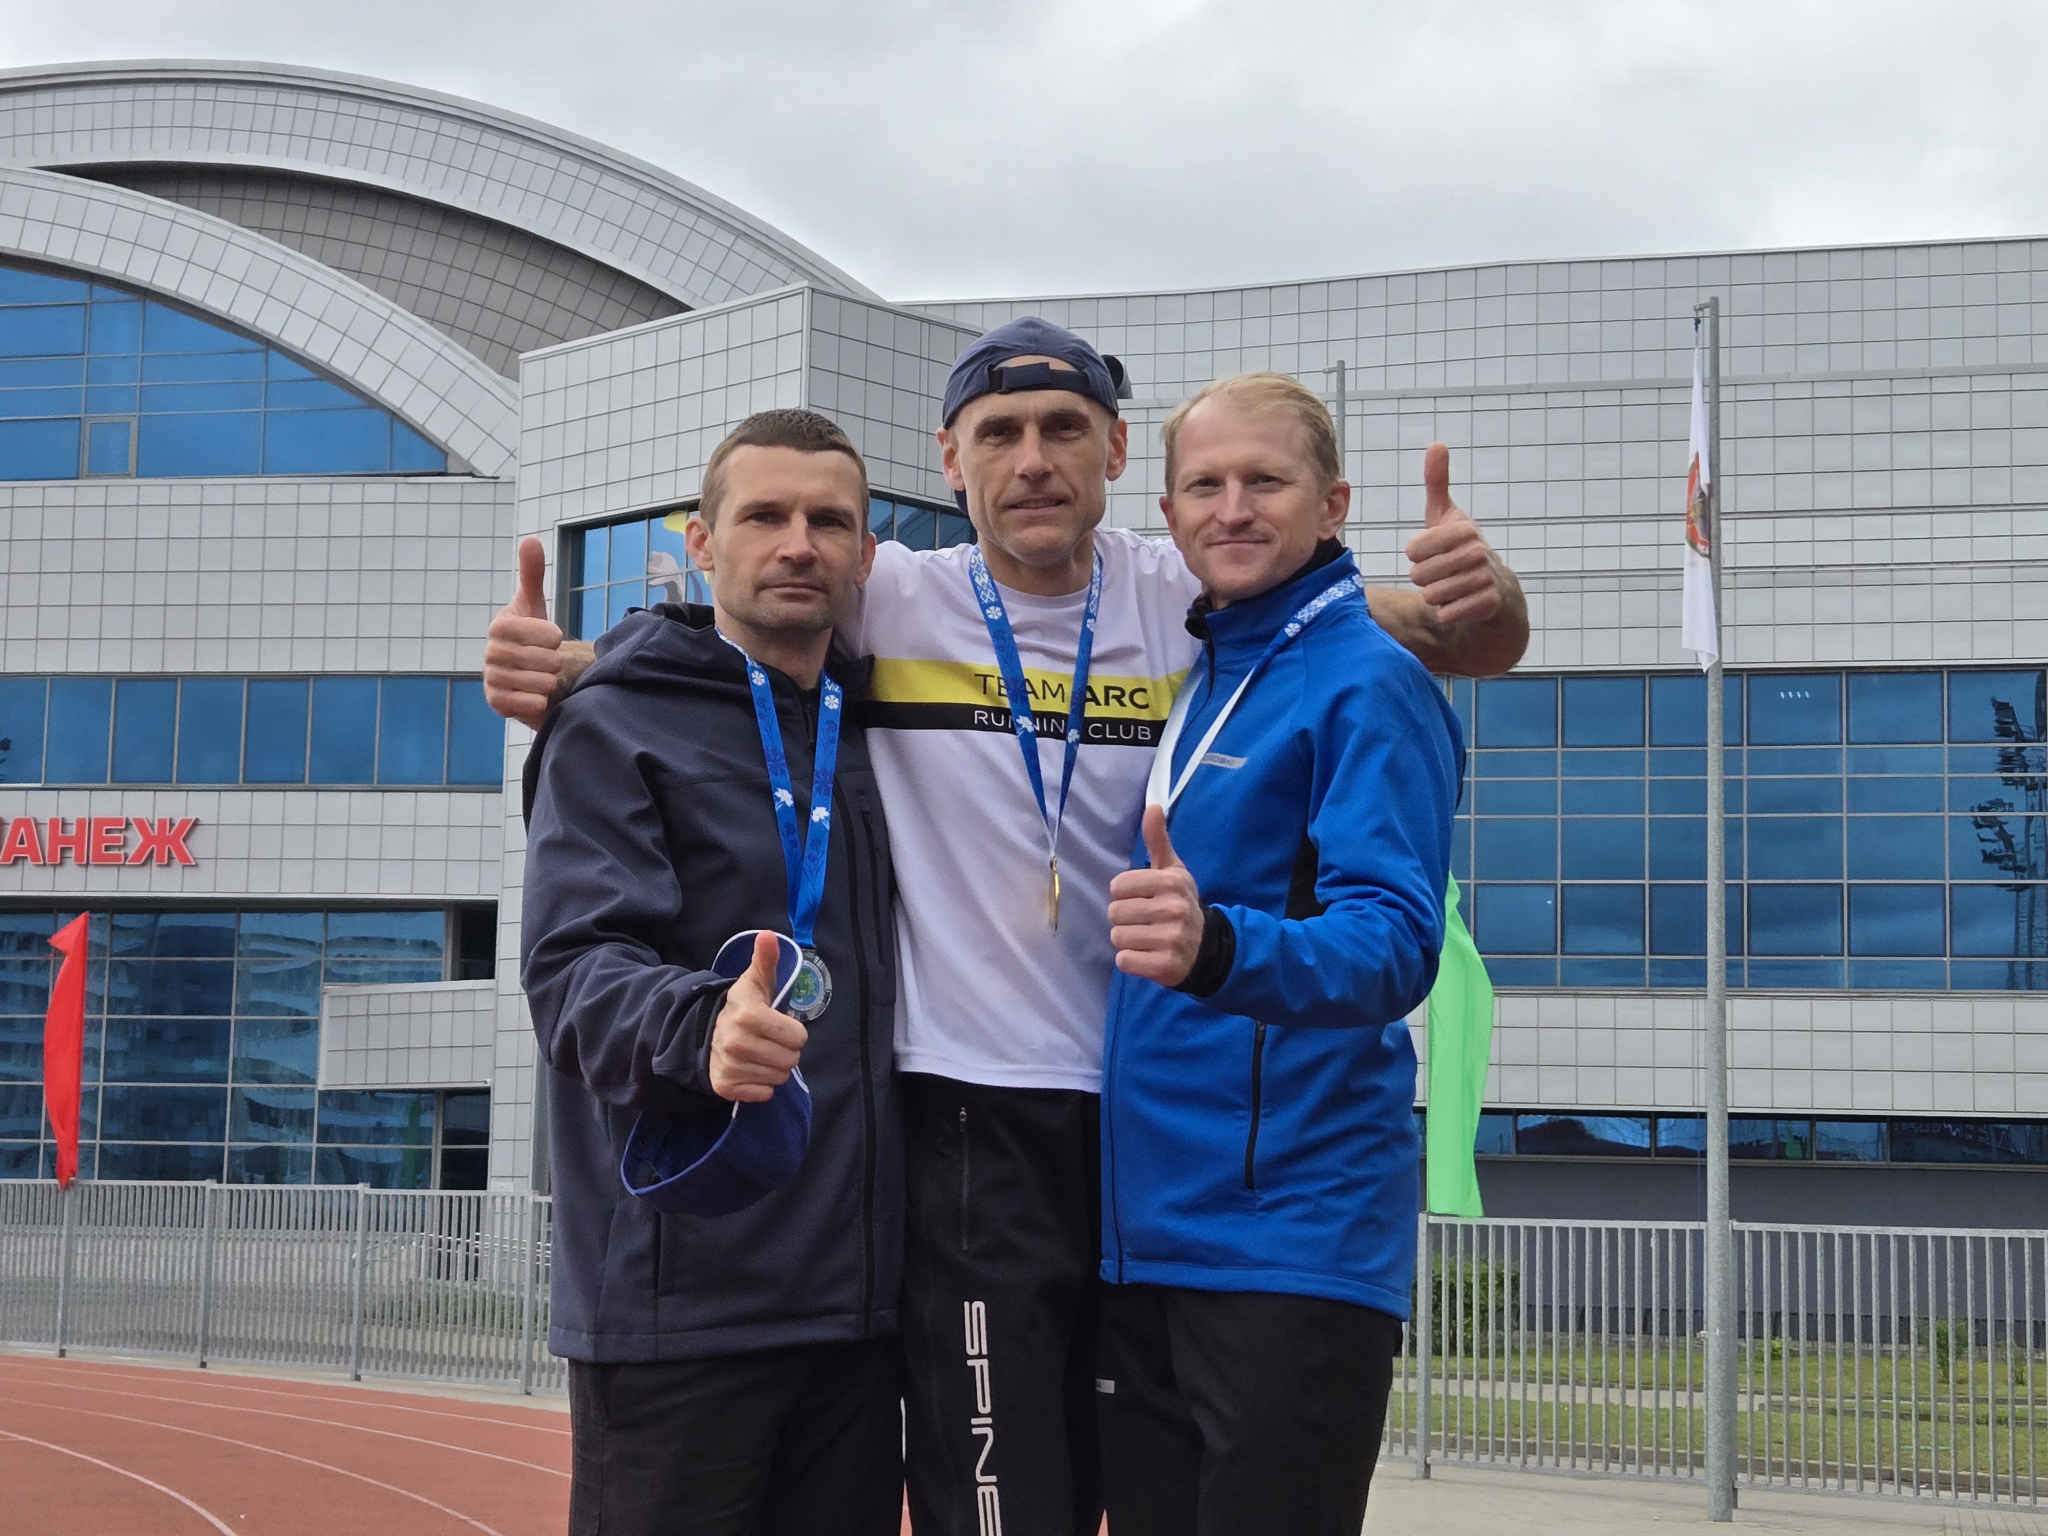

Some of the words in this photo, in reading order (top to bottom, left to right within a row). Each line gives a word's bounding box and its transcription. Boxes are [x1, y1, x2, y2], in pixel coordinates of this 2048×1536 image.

[1085, 685, 1150, 709] ARC
[1088, 723, 1151, 740] CLUB
[0, 817, 197, 866] АНЕЖ
[963, 1300, 1003, 1536] SPINE
